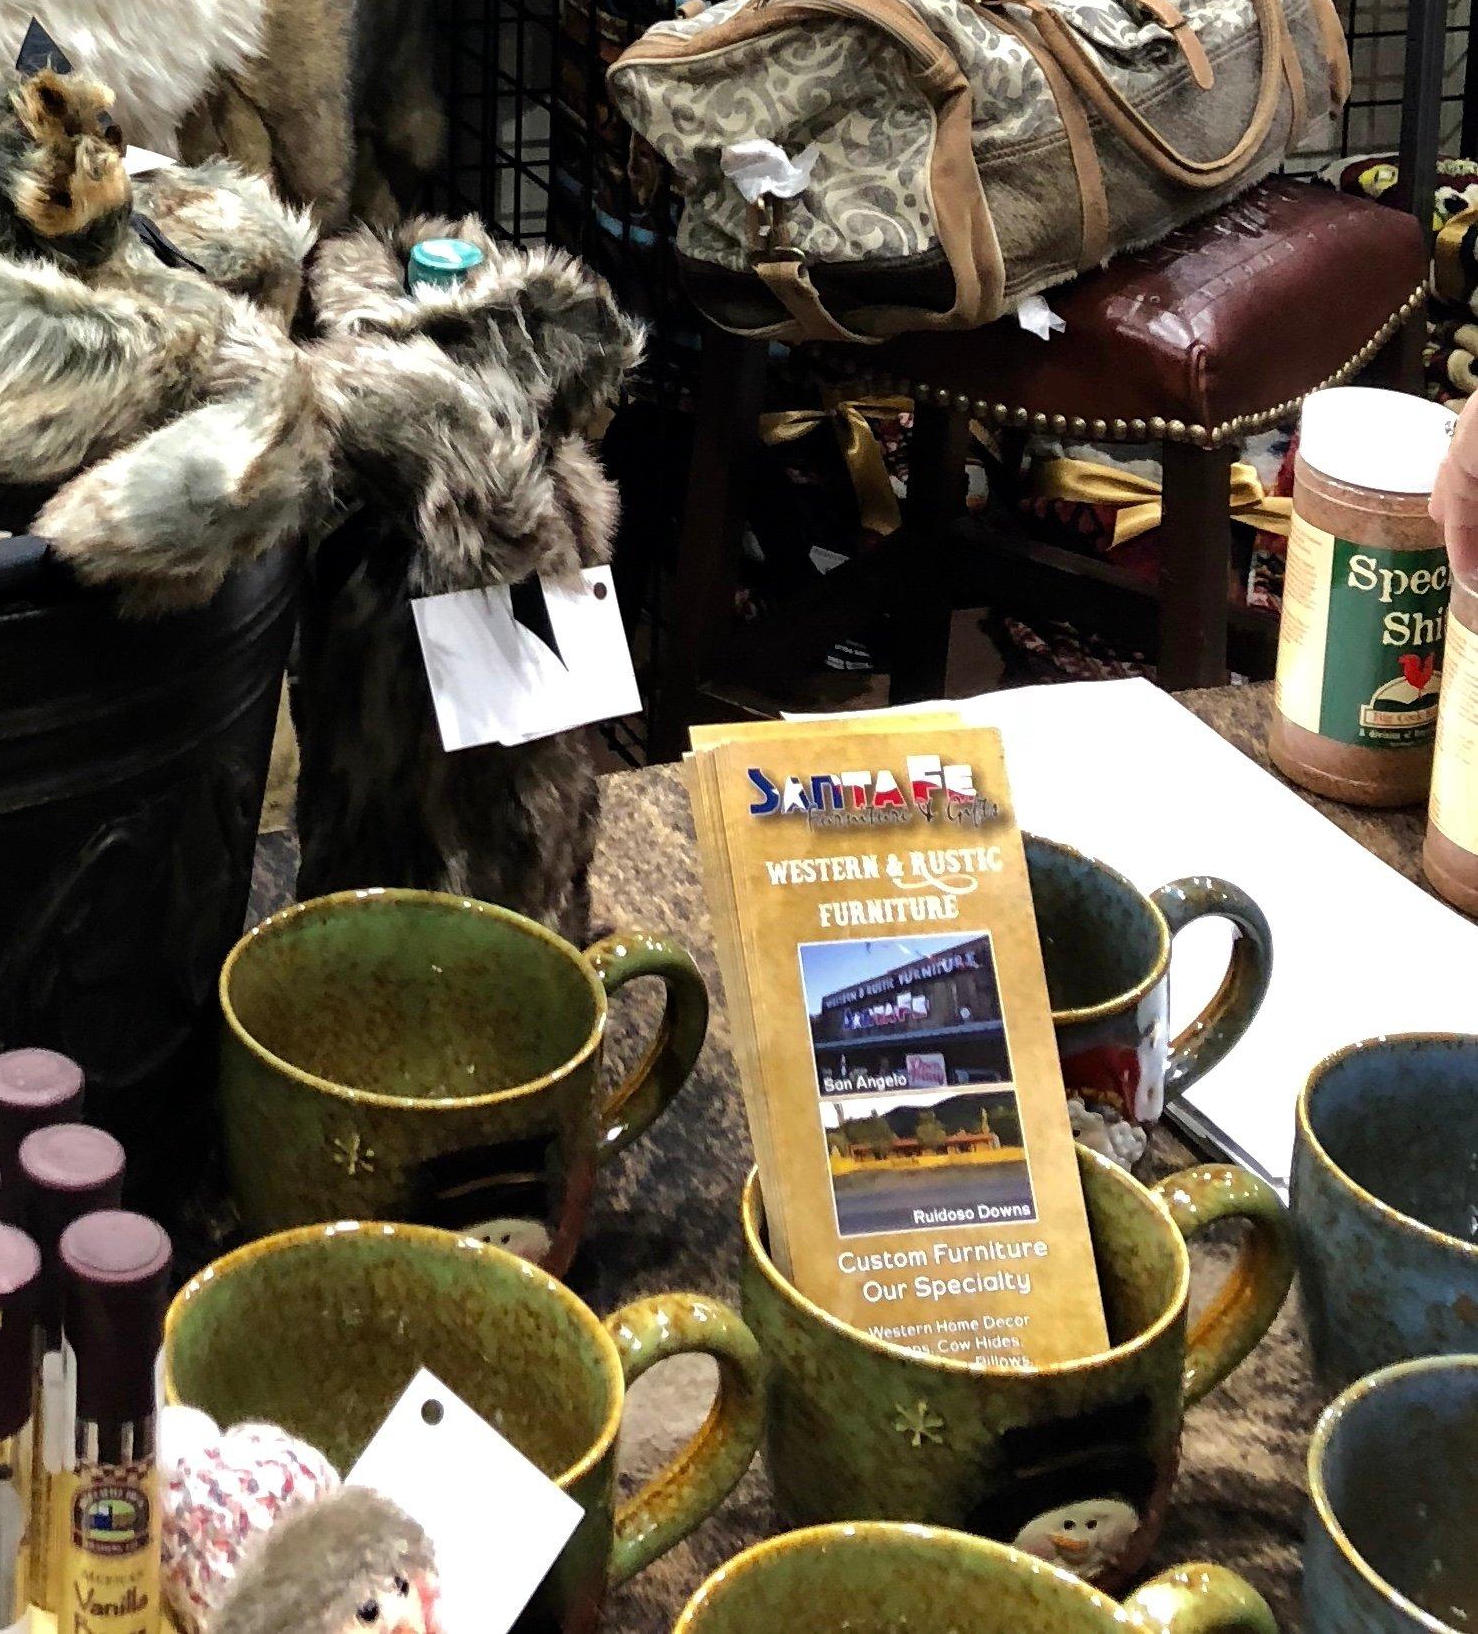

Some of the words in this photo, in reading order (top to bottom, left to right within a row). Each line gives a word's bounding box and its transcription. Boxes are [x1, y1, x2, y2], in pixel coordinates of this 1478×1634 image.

[1382, 606, 1444, 646] Shi
[747, 767, 908, 816] SANTA
[906, 754, 977, 804] FE
[766, 854, 880, 886] WESTERN
[885, 853, 905, 878] &
[909, 846, 1004, 888] RUSTIC
[818, 895, 959, 928] FURNITURE
[824, 1077, 853, 1092] San
[856, 1074, 907, 1091] Angelo
[912, 1207, 975, 1224] Ruidoso
[978, 1203, 1031, 1219] Downs
[838, 1250, 928, 1274] Custom
[932, 1239, 1048, 1265] Furniture
[862, 1280, 907, 1303] Our
[914, 1270, 1031, 1301] Specialty
[868, 1323, 933, 1340] Western
[936, 1318, 979, 1333] Home
[983, 1315, 1031, 1329] Decor
[937, 1339, 970, 1353] Cow
